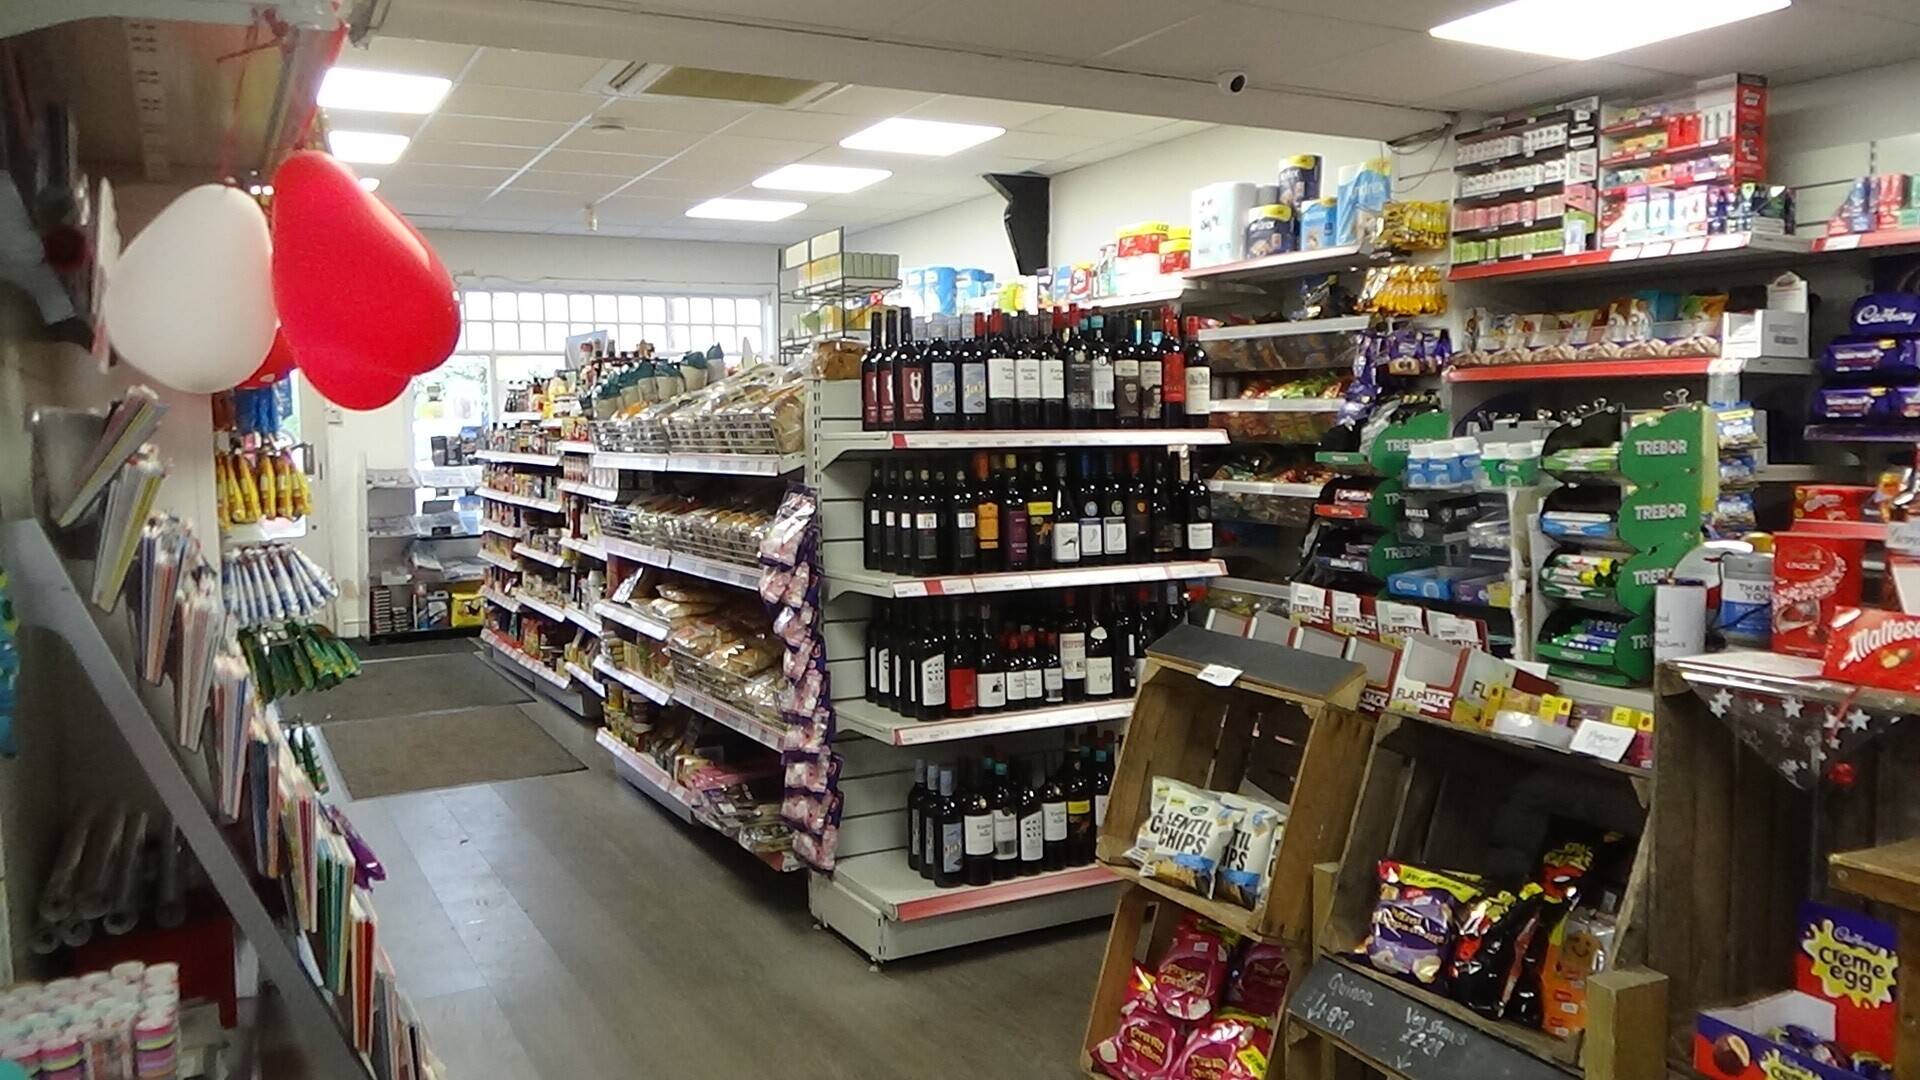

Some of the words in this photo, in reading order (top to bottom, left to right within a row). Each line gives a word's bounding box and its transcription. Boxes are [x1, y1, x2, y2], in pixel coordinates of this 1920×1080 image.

[1856, 304, 1917, 326] Cadbury
[1635, 440, 1688, 456] TREBOR
[1634, 504, 1687, 520] TREBOR
[1739, 583, 1770, 592] THAN
[1846, 618, 1920, 665] Maltese
[1364, 691, 1389, 709] JACK
[1395, 687, 1453, 709] FLAPJACK
[1167, 811, 1213, 838] LENTIL
[1158, 825, 1207, 856] CHIPS
[1233, 828, 1252, 851] TIL
[1221, 845, 1248, 872] IPS
[1819, 946, 1886, 980] Creme
[1829, 965, 1873, 994] egg
